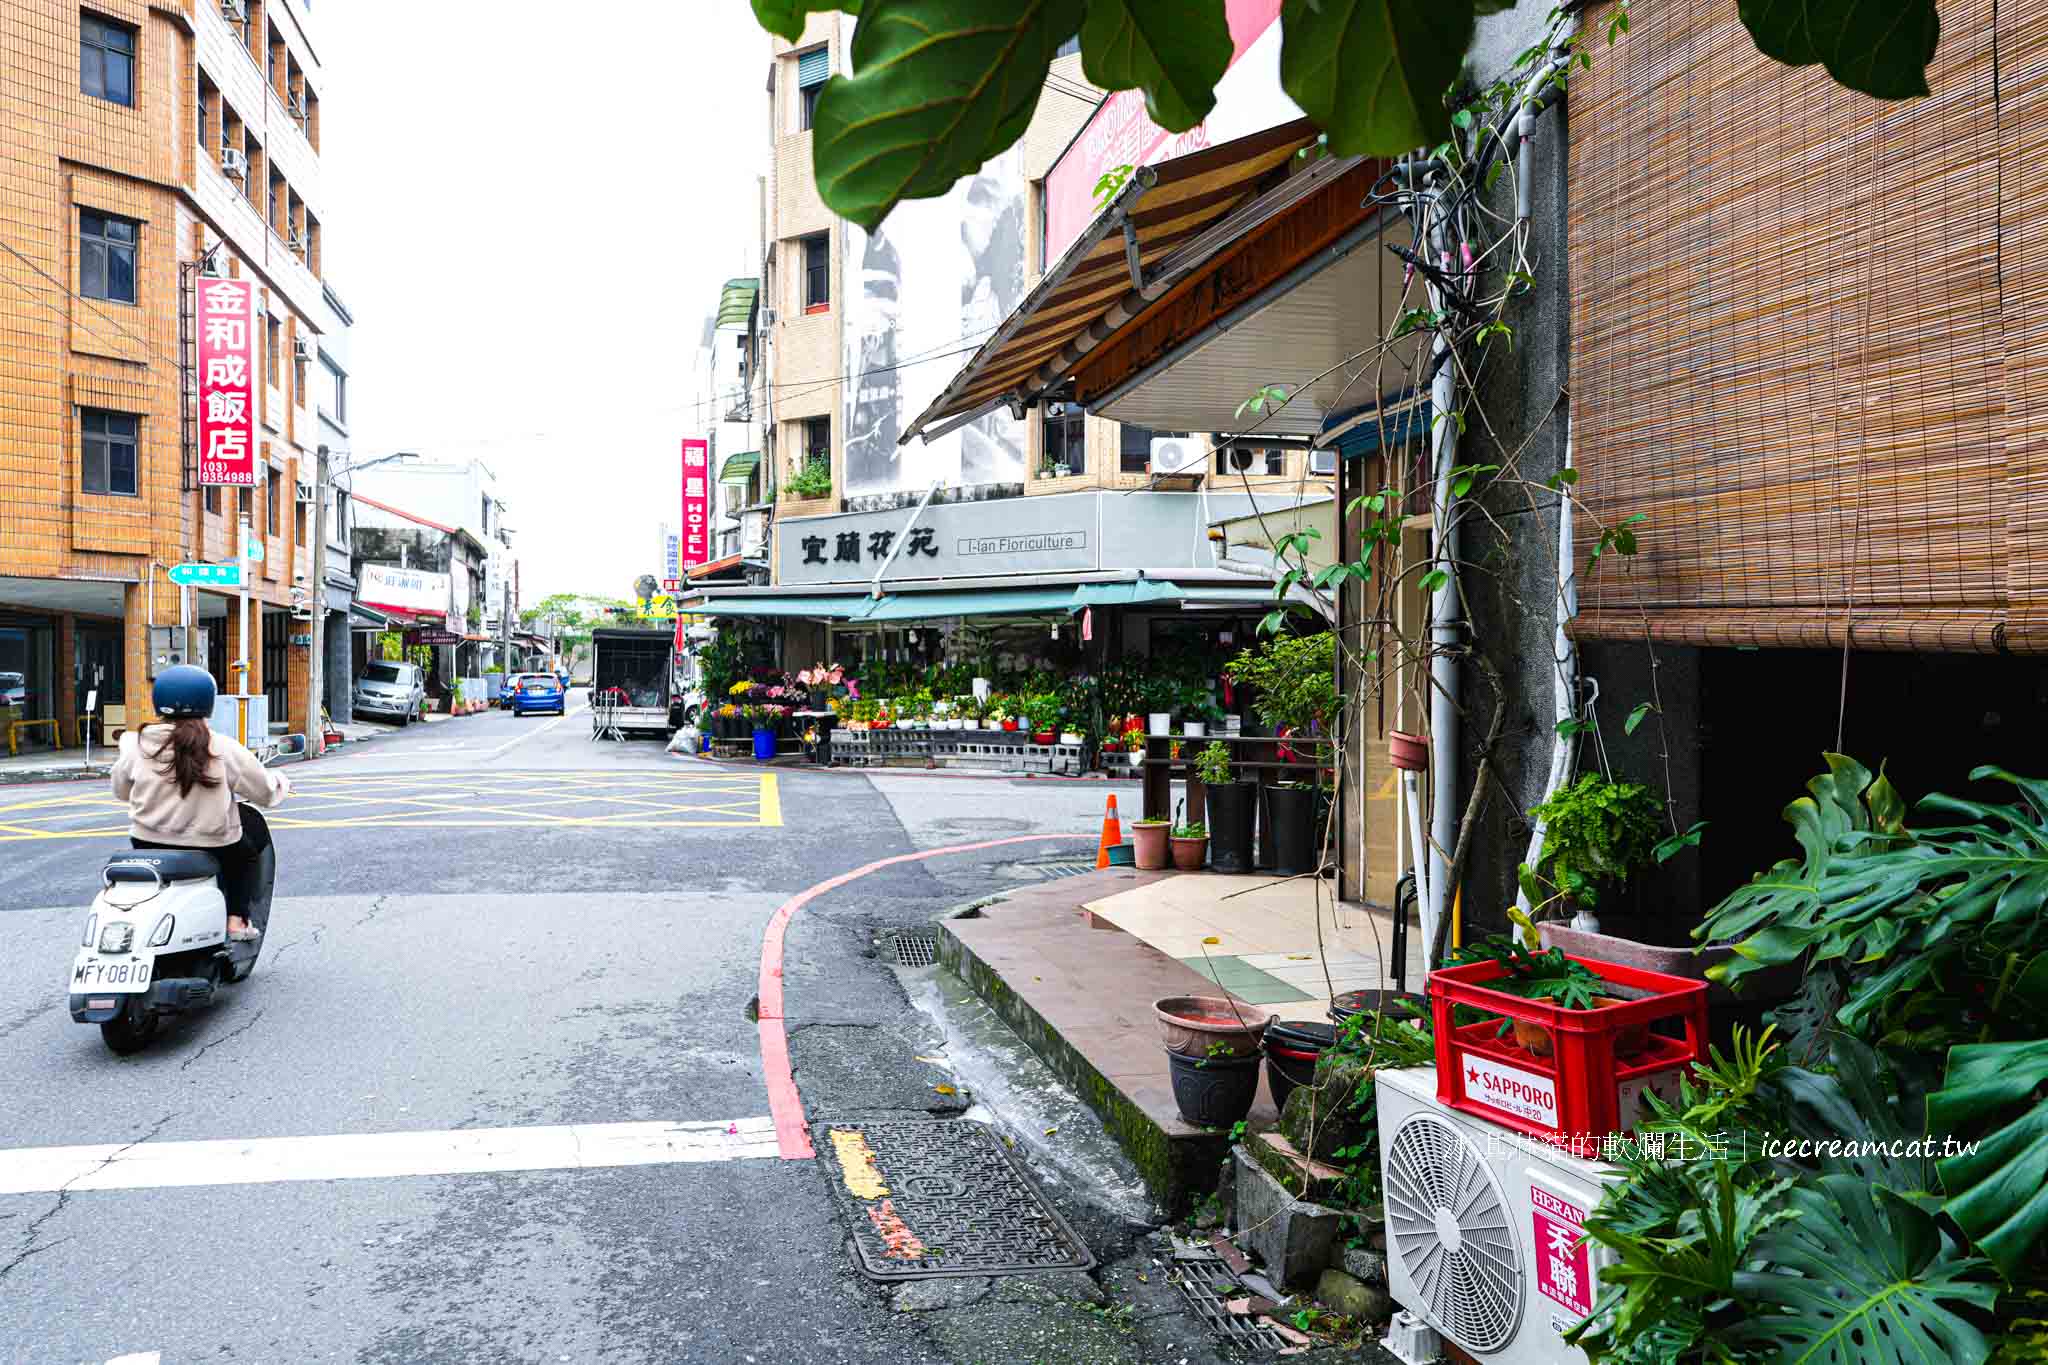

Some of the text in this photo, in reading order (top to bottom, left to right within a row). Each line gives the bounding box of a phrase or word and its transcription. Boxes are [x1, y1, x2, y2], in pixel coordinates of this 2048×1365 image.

[204, 281, 248, 460] 金和成飯店
[203, 461, 228, 473] (03)
[687, 503, 703, 554] HOTEL
[801, 526, 939, 565] 宜蘭花苑
[999, 535, 1074, 552] Floriculture
[1482, 1071, 1555, 1111] SAPPORO
[1532, 1186, 1585, 1223] HERAN
[1546, 1222, 1577, 1297] 禾聯
